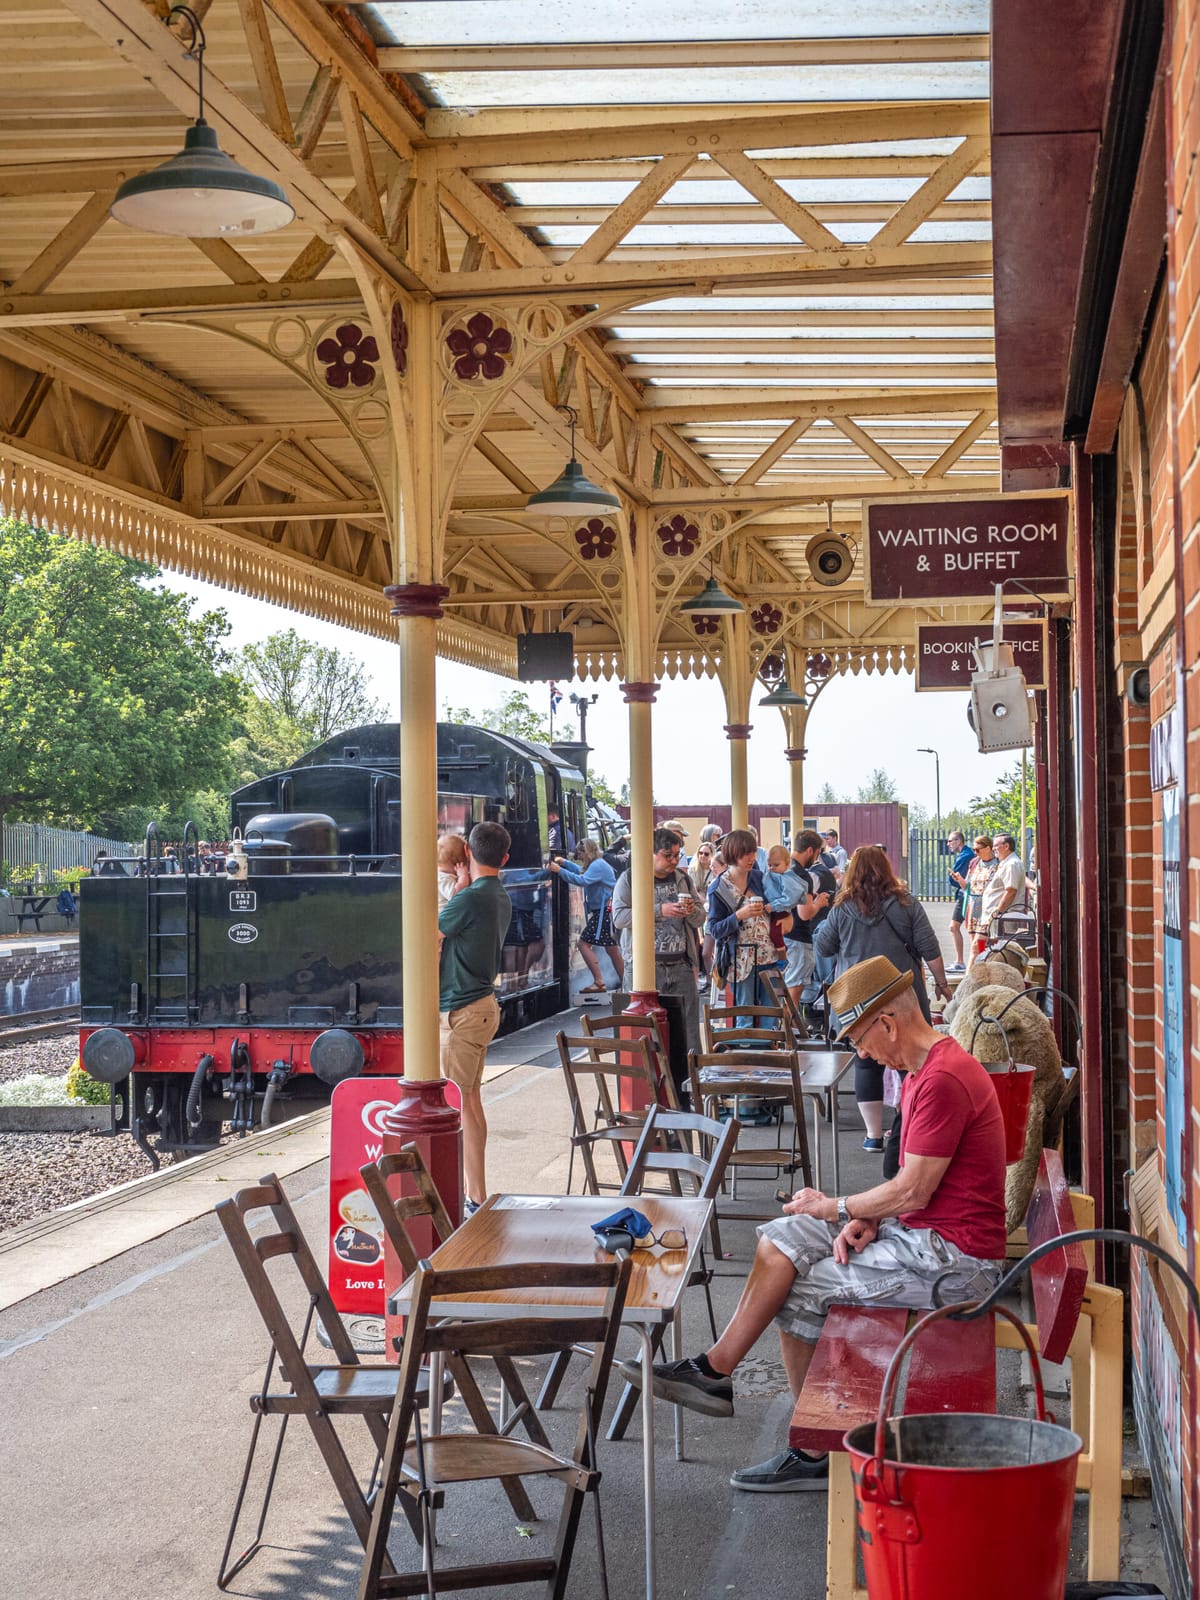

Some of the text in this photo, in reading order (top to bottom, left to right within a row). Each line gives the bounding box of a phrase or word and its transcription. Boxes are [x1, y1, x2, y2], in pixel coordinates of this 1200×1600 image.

[877, 523, 1058, 547] WAITING ROOM
[916, 551, 1020, 572] & BUFFET
[923, 640, 1040, 655] BOOKIN FICE
[951, 659, 960, 671] &
[345, 1278, 375, 1289] Love
